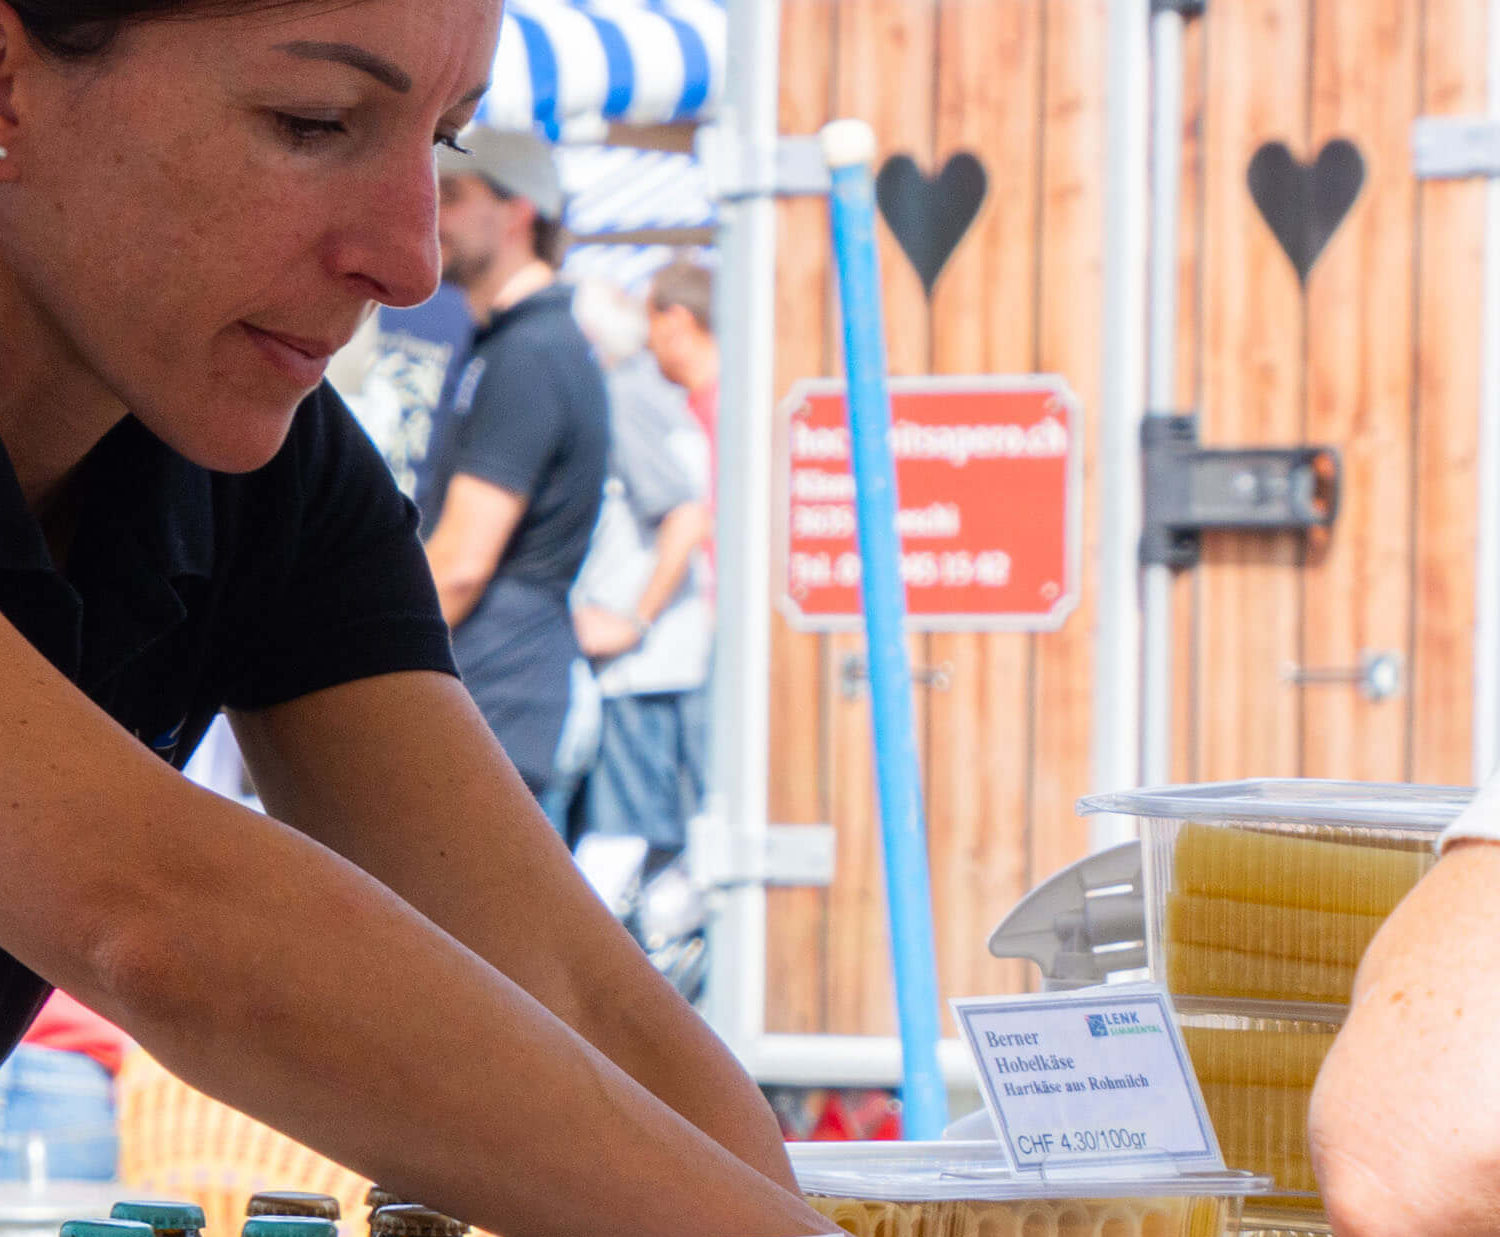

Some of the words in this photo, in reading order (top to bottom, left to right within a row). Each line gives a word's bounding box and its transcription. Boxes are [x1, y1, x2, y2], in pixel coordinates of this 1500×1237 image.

[1105, 1011, 1140, 1025] LENK
[985, 1030, 1040, 1048] Berner
[995, 1055, 1076, 1074] Hobelkäse
[1004, 1080, 1062, 1097] Hartkäse
[1065, 1081, 1087, 1093] aus
[1088, 1073, 1150, 1091] Rohmilch
[1017, 1133, 1055, 1155] CHF
[1060, 1128, 1147, 1152] 4.30/100gr
